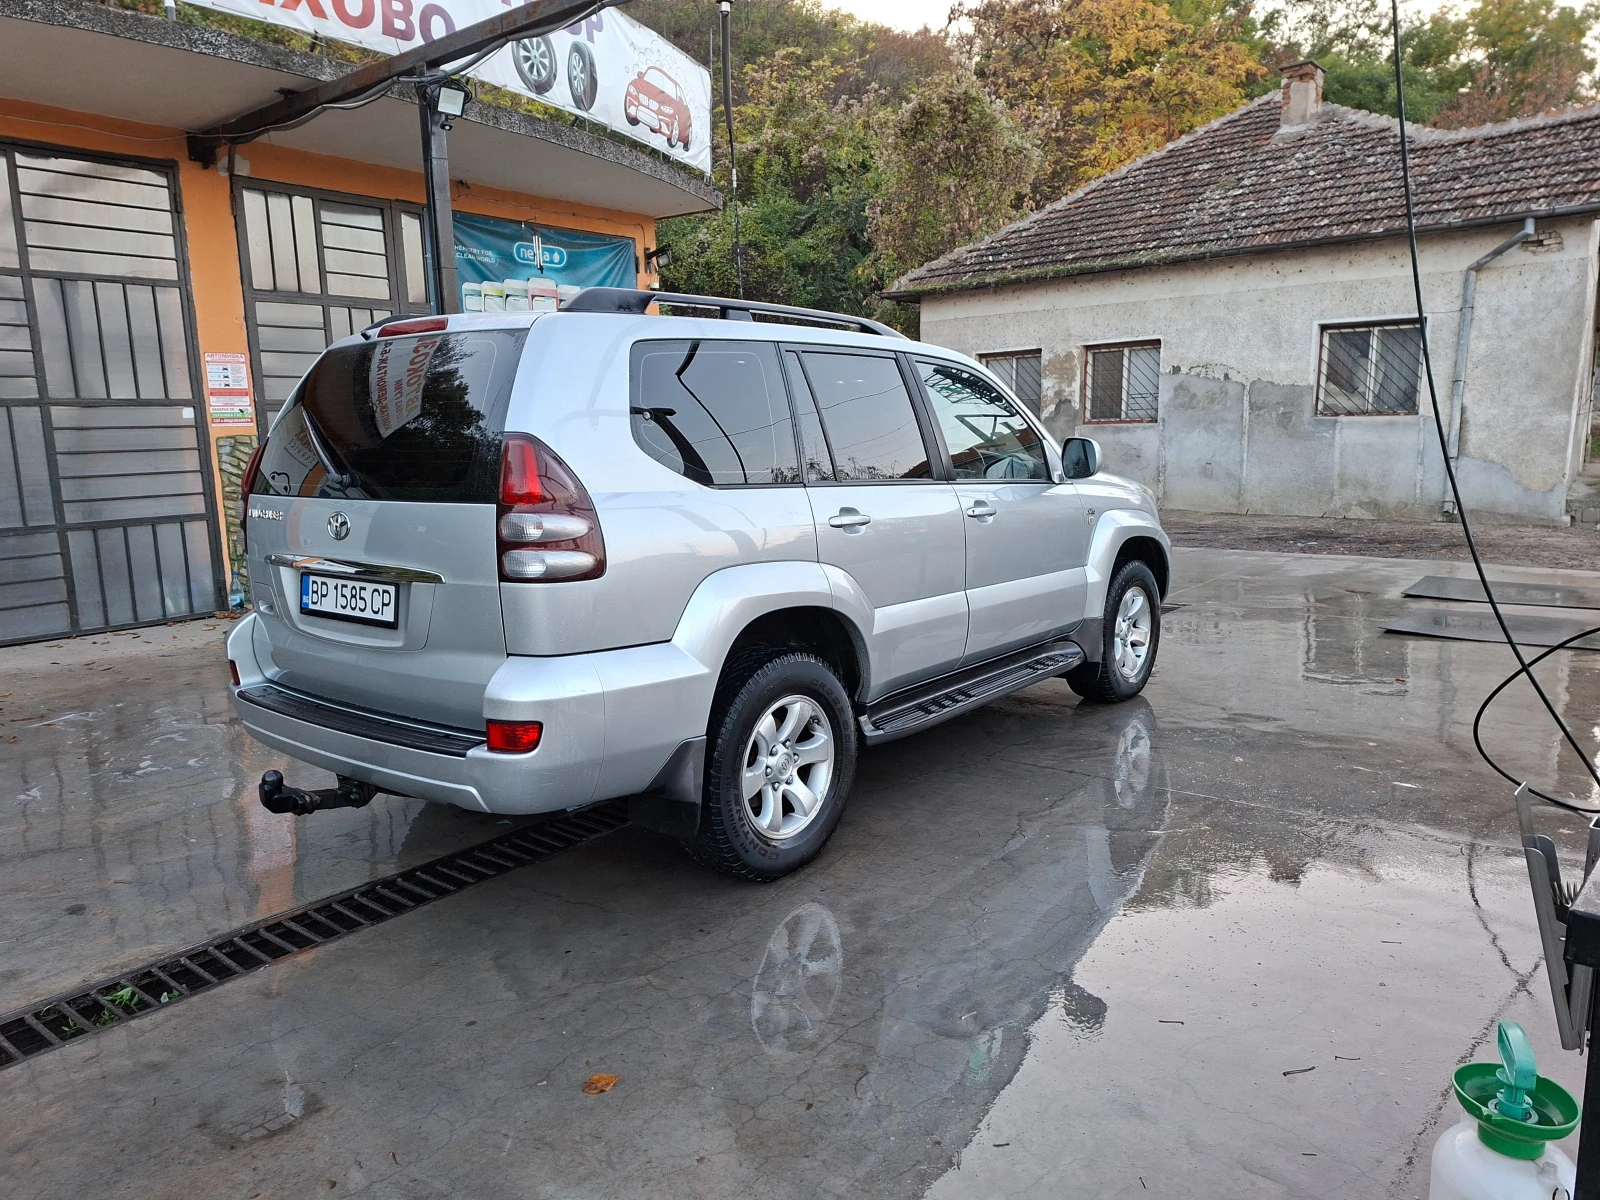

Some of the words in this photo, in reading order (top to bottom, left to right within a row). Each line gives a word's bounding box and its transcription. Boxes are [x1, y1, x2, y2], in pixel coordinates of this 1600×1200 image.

[476, 255, 496, 263] WORLD
[520, 247, 550, 262] nea
[311, 580, 329, 606] BP
[333, 582, 367, 613] 1585
[370, 588, 392, 616] CP
